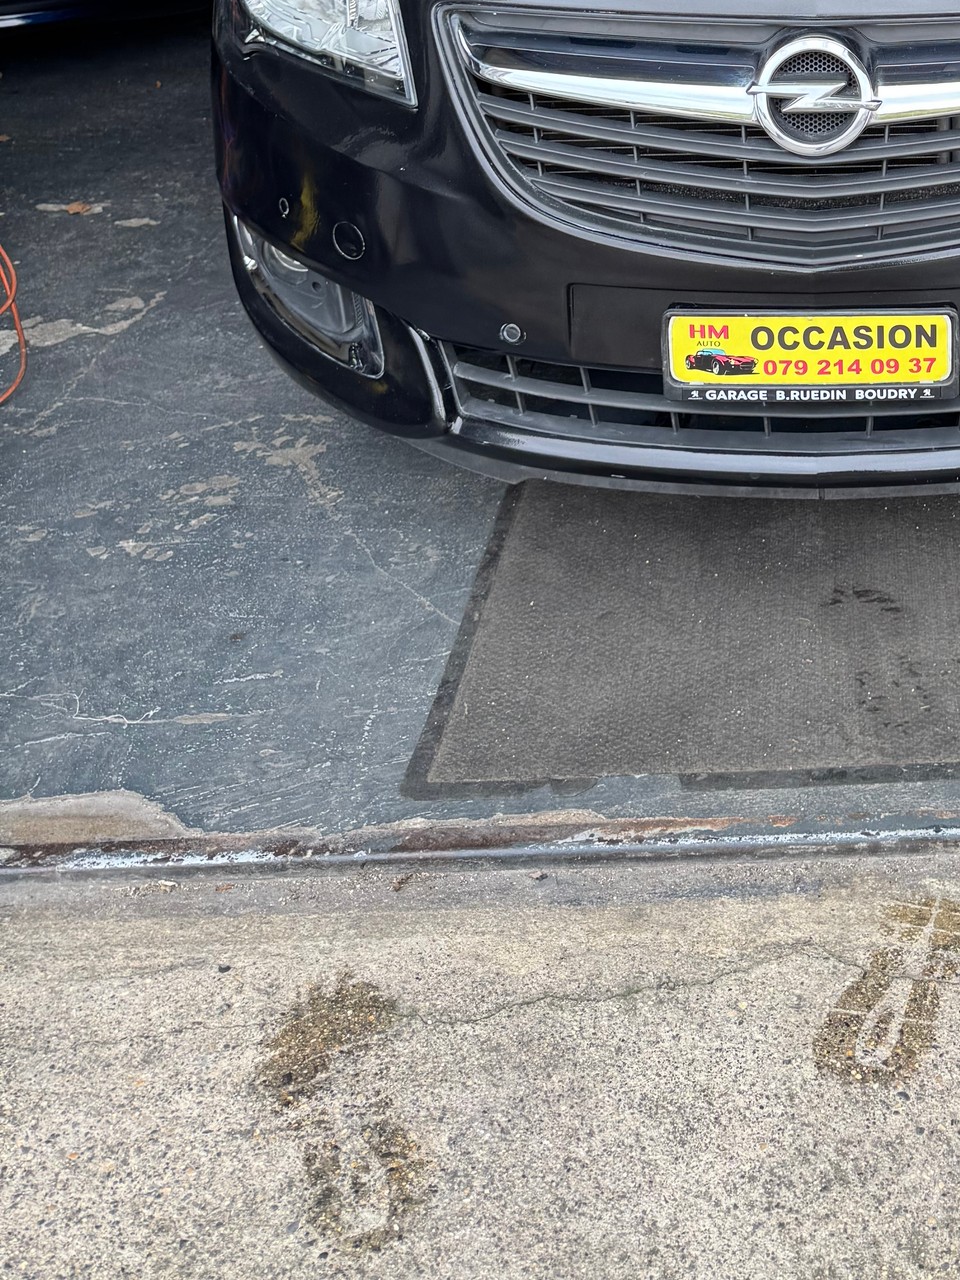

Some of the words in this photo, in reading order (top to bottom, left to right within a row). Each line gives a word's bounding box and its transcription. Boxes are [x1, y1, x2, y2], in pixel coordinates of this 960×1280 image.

[689, 324, 730, 339] HM
[750, 324, 937, 351] OCCASION
[763, 359, 808, 376] 079
[817, 359, 862, 376] 214
[870, 358, 900, 374] 09
[908, 357, 937, 374] 37
[705, 388, 768, 401] GARAGE
[775, 388, 847, 401] B.RUEDIN
[855, 388, 918, 400] BOUDRY
